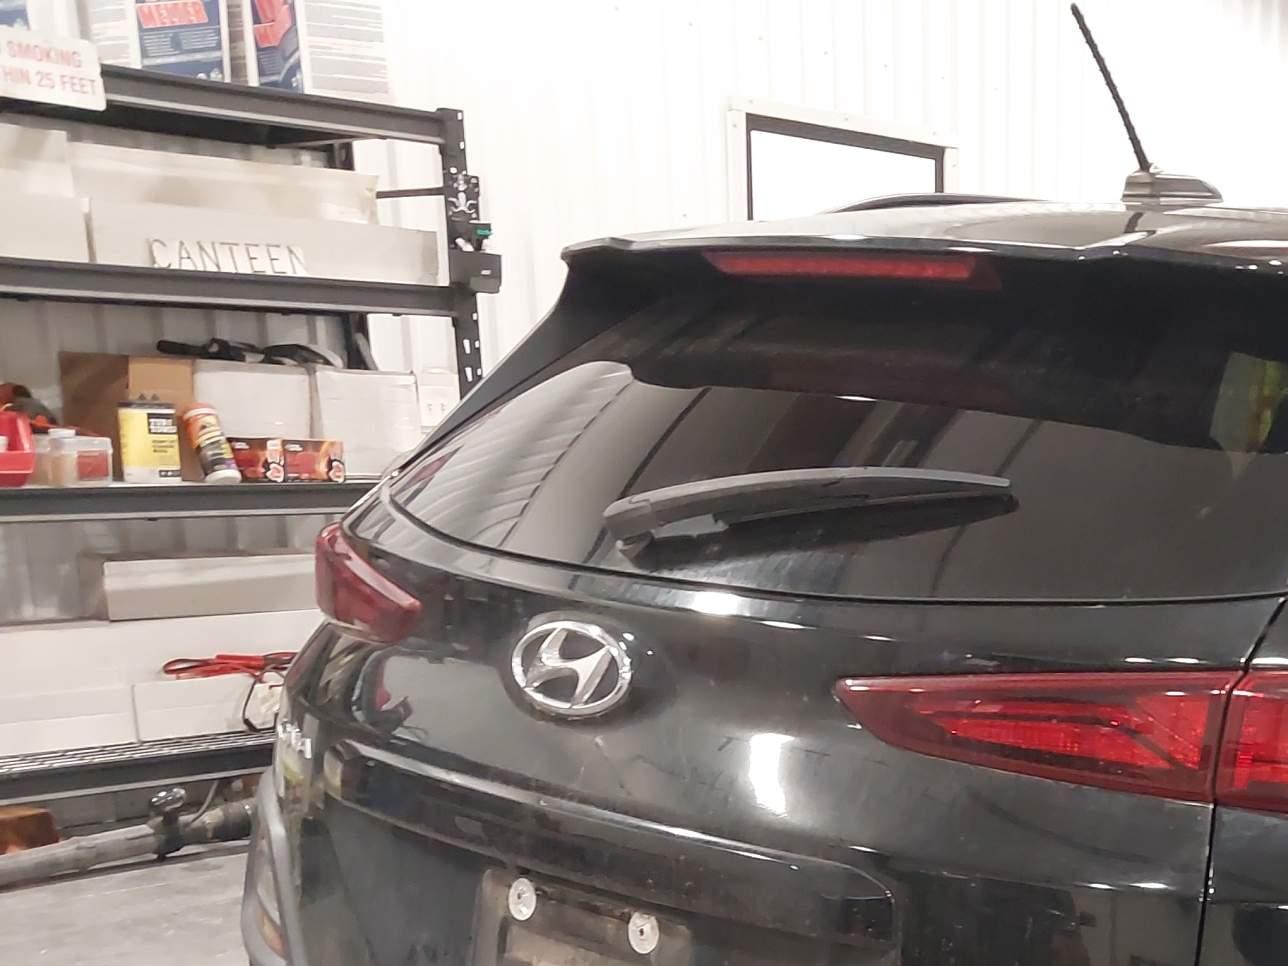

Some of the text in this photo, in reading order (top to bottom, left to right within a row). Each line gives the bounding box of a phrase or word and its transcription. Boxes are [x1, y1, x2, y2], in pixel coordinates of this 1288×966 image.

[7, 41, 81, 68] SMOKING
[36, 71, 55, 89] 25
[60, 75, 96, 95] FEET
